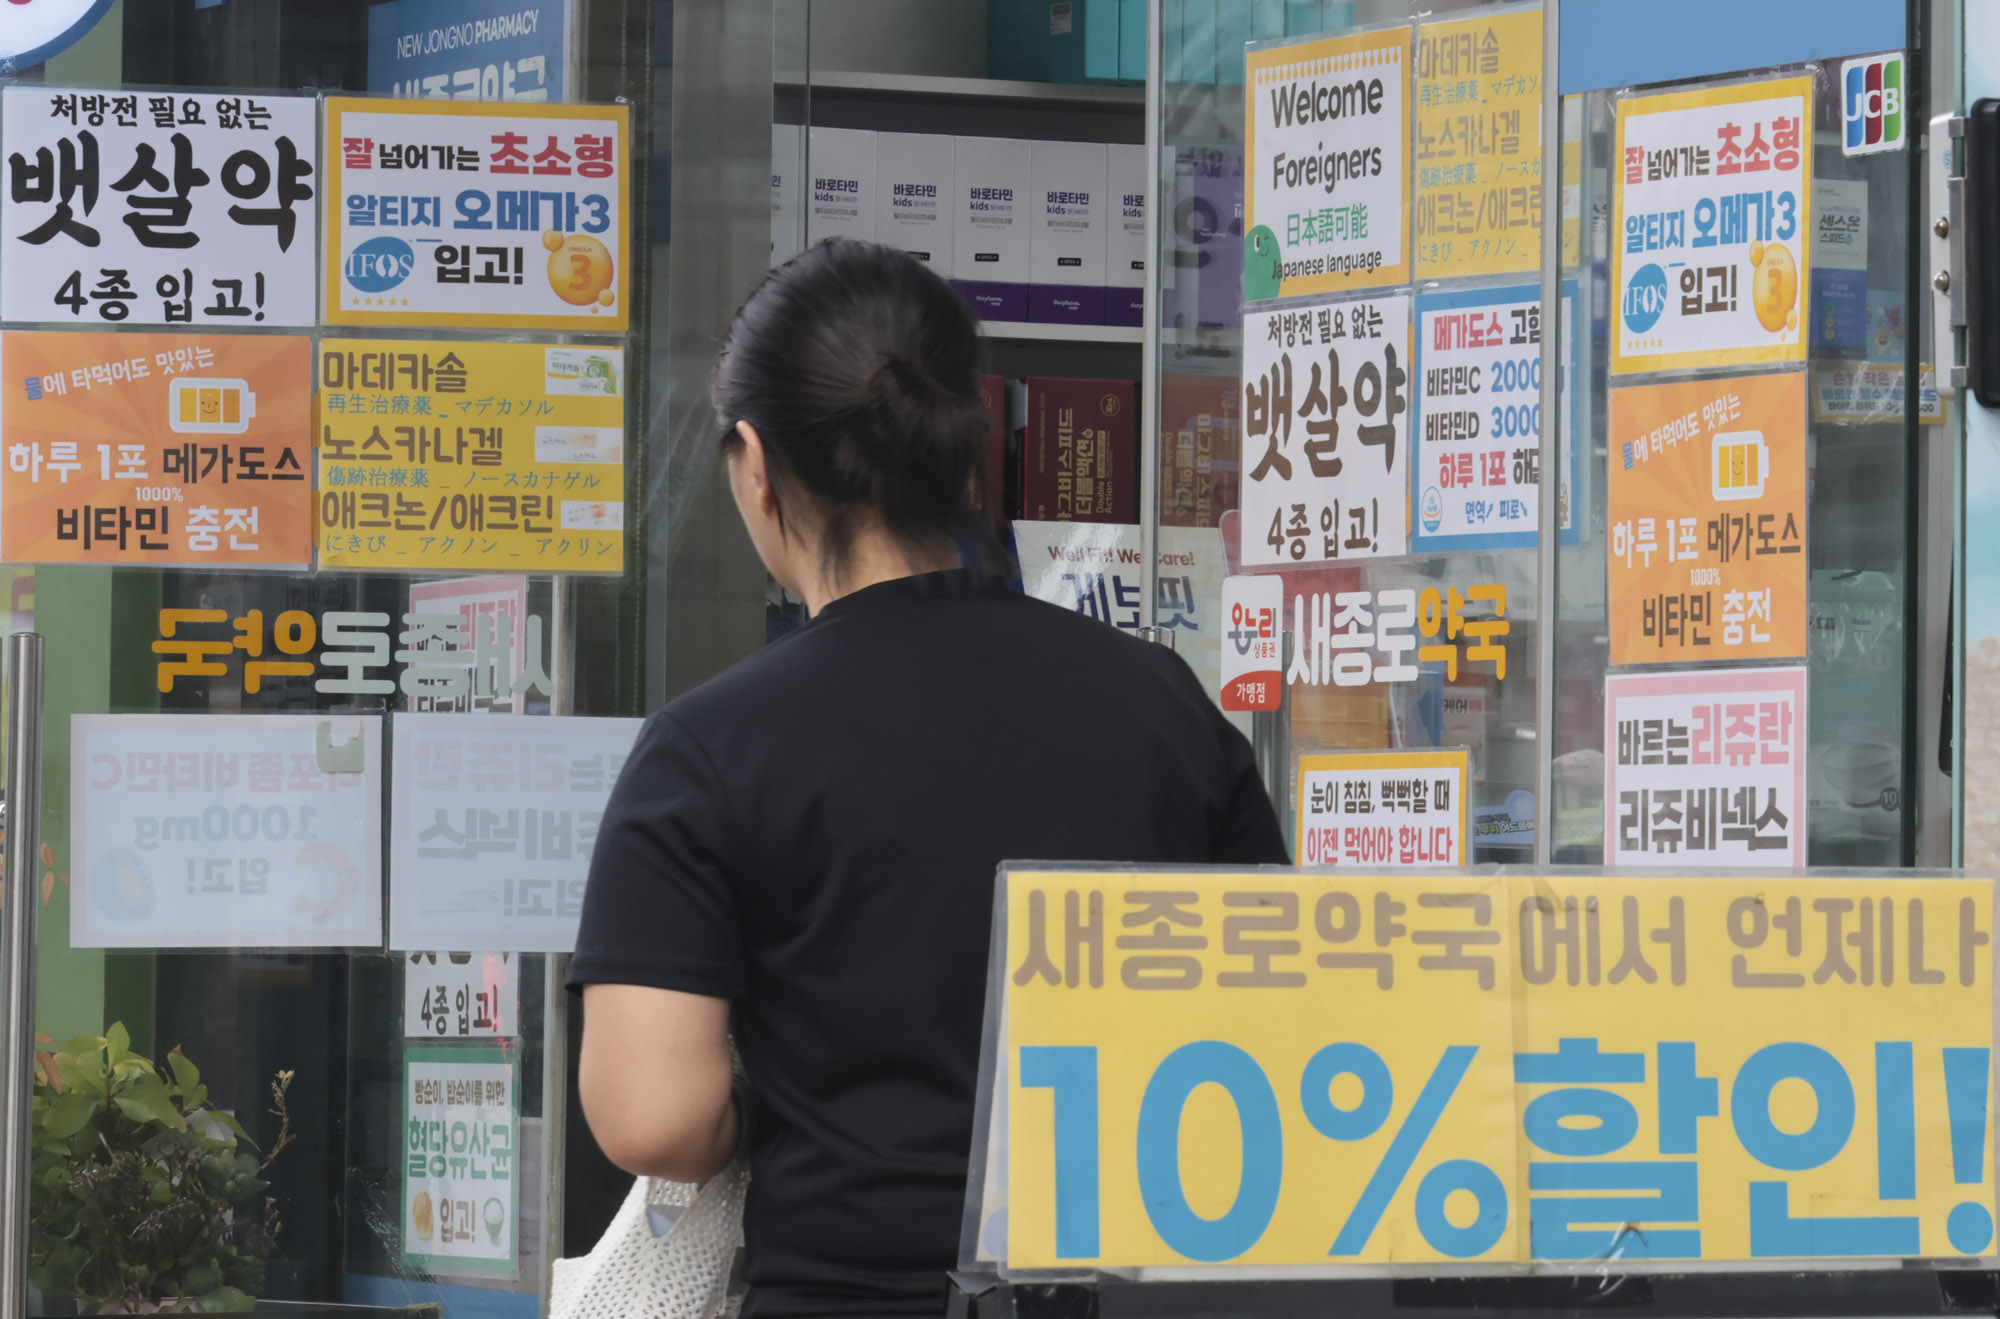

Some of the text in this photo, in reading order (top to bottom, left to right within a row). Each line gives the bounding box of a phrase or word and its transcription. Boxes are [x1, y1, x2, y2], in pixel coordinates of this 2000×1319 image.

[397, 9, 539, 59] NEW JONGNO PHARMACY
[1419, 27, 1499, 80] 마데카솔
[50, 94, 272, 130] 처방전 필요 없는
[1271, 78, 1383, 128] Welcome
[1844, 87, 1900, 122] JCB
[1417, 109, 1520, 160] 노스카나겔
[1625, 116, 1800, 185] 잘 넘어가는 초소형
[343, 132, 614, 178] 잘 넘어가는 초소형
[1273, 141, 1382, 194] Foreigners
[8, 130, 314, 254] 뱃살약
[814, 191, 834, 202] kids
[815, 178, 859, 193] 바로타민
[893, 183, 937, 197] 바로타민
[893, 197, 913, 207] kids
[970, 187, 1013, 201] 바로타민
[1047, 191, 1089, 205] 바로타민
[346, 189, 610, 234] 알티지 오메가3
[970, 201, 989, 211] kids
[1046, 205, 1066, 215] kids
[1123, 208, 1142, 218] kids
[1287, 202, 1368, 248] 日本語可能
[1626, 190, 1797, 254] 알티지 오메가3
[1418, 240, 1453, 263] にきび
[1819, 233, 1845, 244] 스피드
[346, 253, 413, 279] IFOS
[434, 245, 524, 285] 입고!
[568, 254, 593, 291] 3
[1272, 250, 1382, 282] Japanese language
[54, 268, 265, 322] 4종 입고!
[1623, 284, 1666, 316] IFOS
[1680, 264, 1737, 316] 입고!
[1766, 268, 1783, 315] 3
[1268, 310, 1313, 349] 처방전
[1318, 307, 1346, 345] 필요
[1351, 304, 1383, 340] 없는
[1433, 311, 1504, 351] 메가도스
[24, 346, 214, 401] 물에 타먹어도 맛있는
[323, 351, 468, 393] 마데카솔
[1427, 366, 1481, 397] 비타민C
[327, 394, 555, 416] 再生治療薬 マデカソル
[1245, 342, 1406, 482] 뱃살약
[322, 425, 503, 466] 노스카나겔
[1426, 411, 1480, 442] 비타민D
[1622, 393, 1741, 471] 물에 타먹어도 맛있는
[9, 441, 305, 484] 하루 1포 메가도스
[327, 466, 601, 490] 傷跡治療薬 ノースカナゲル
[1075, 439, 1094, 515] 더블액션
[1439, 452, 1474, 489] 하루
[1479, 451, 1506, 486] 1포
[135, 486, 184, 502] 1000%
[322, 491, 553, 534] 애크논/애크린
[1096, 481, 1105, 514] Double
[1104, 481, 1113, 514] Action
[1465, 500, 1486, 524] 면역
[1499, 498, 1520, 520] 피로
[57, 505, 259, 551] 비타민 충전
[326, 534, 613, 558] にきび アクノン アクリン
[1267, 497, 1378, 561] 4종 입고!
[1612, 512, 1801, 568] 하루 1포 메가도스
[1159, 551, 1195, 566] are!
[1690, 568, 1721, 586] 1000%
[1286, 583, 1510, 687] 새종로약국
[1643, 587, 1771, 648] 비타민 충전
[1254, 641, 1276, 659] 상품권
[1236, 682, 1266, 704] 가맹점
[1311, 778, 1450, 814] 눈이 침침, 뻑뻑할 때
[1620, 786, 1789, 854] 리쥬비넥스
[1307, 824, 1453, 864] 이젠 먹어야 합니다
[1724, 890, 1991, 990] 언제나
[421, 983, 498, 1035] 4종 입고!
[415, 1079, 506, 1107] 빵순이, 밥순이를 위한
[409, 1115, 512, 1181] 혈당유산균
[1018, 1036, 1996, 1263] 10% 할인!
[440, 1198, 476, 1243] 입고!
